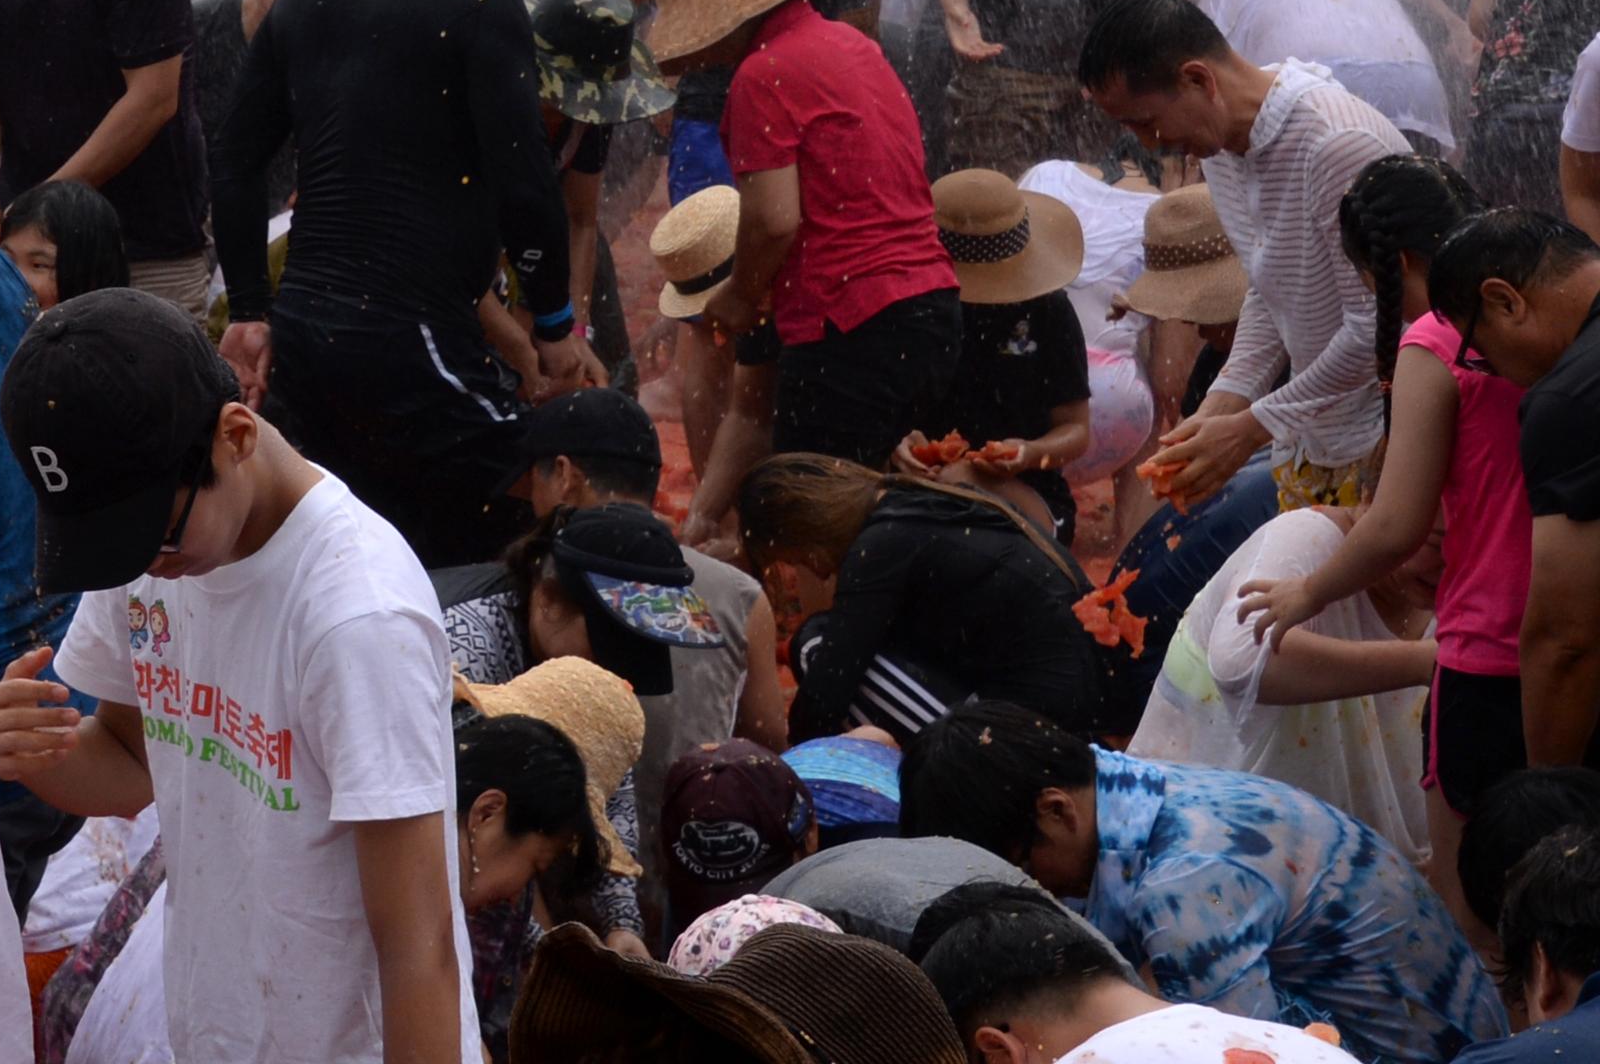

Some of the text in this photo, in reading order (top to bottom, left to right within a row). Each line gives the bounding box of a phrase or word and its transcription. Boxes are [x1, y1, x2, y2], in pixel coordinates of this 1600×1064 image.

[30, 446, 69, 493] B
[199, 737, 300, 812] FESTIVAL
[671, 840, 735, 880] TOKYO CITY
